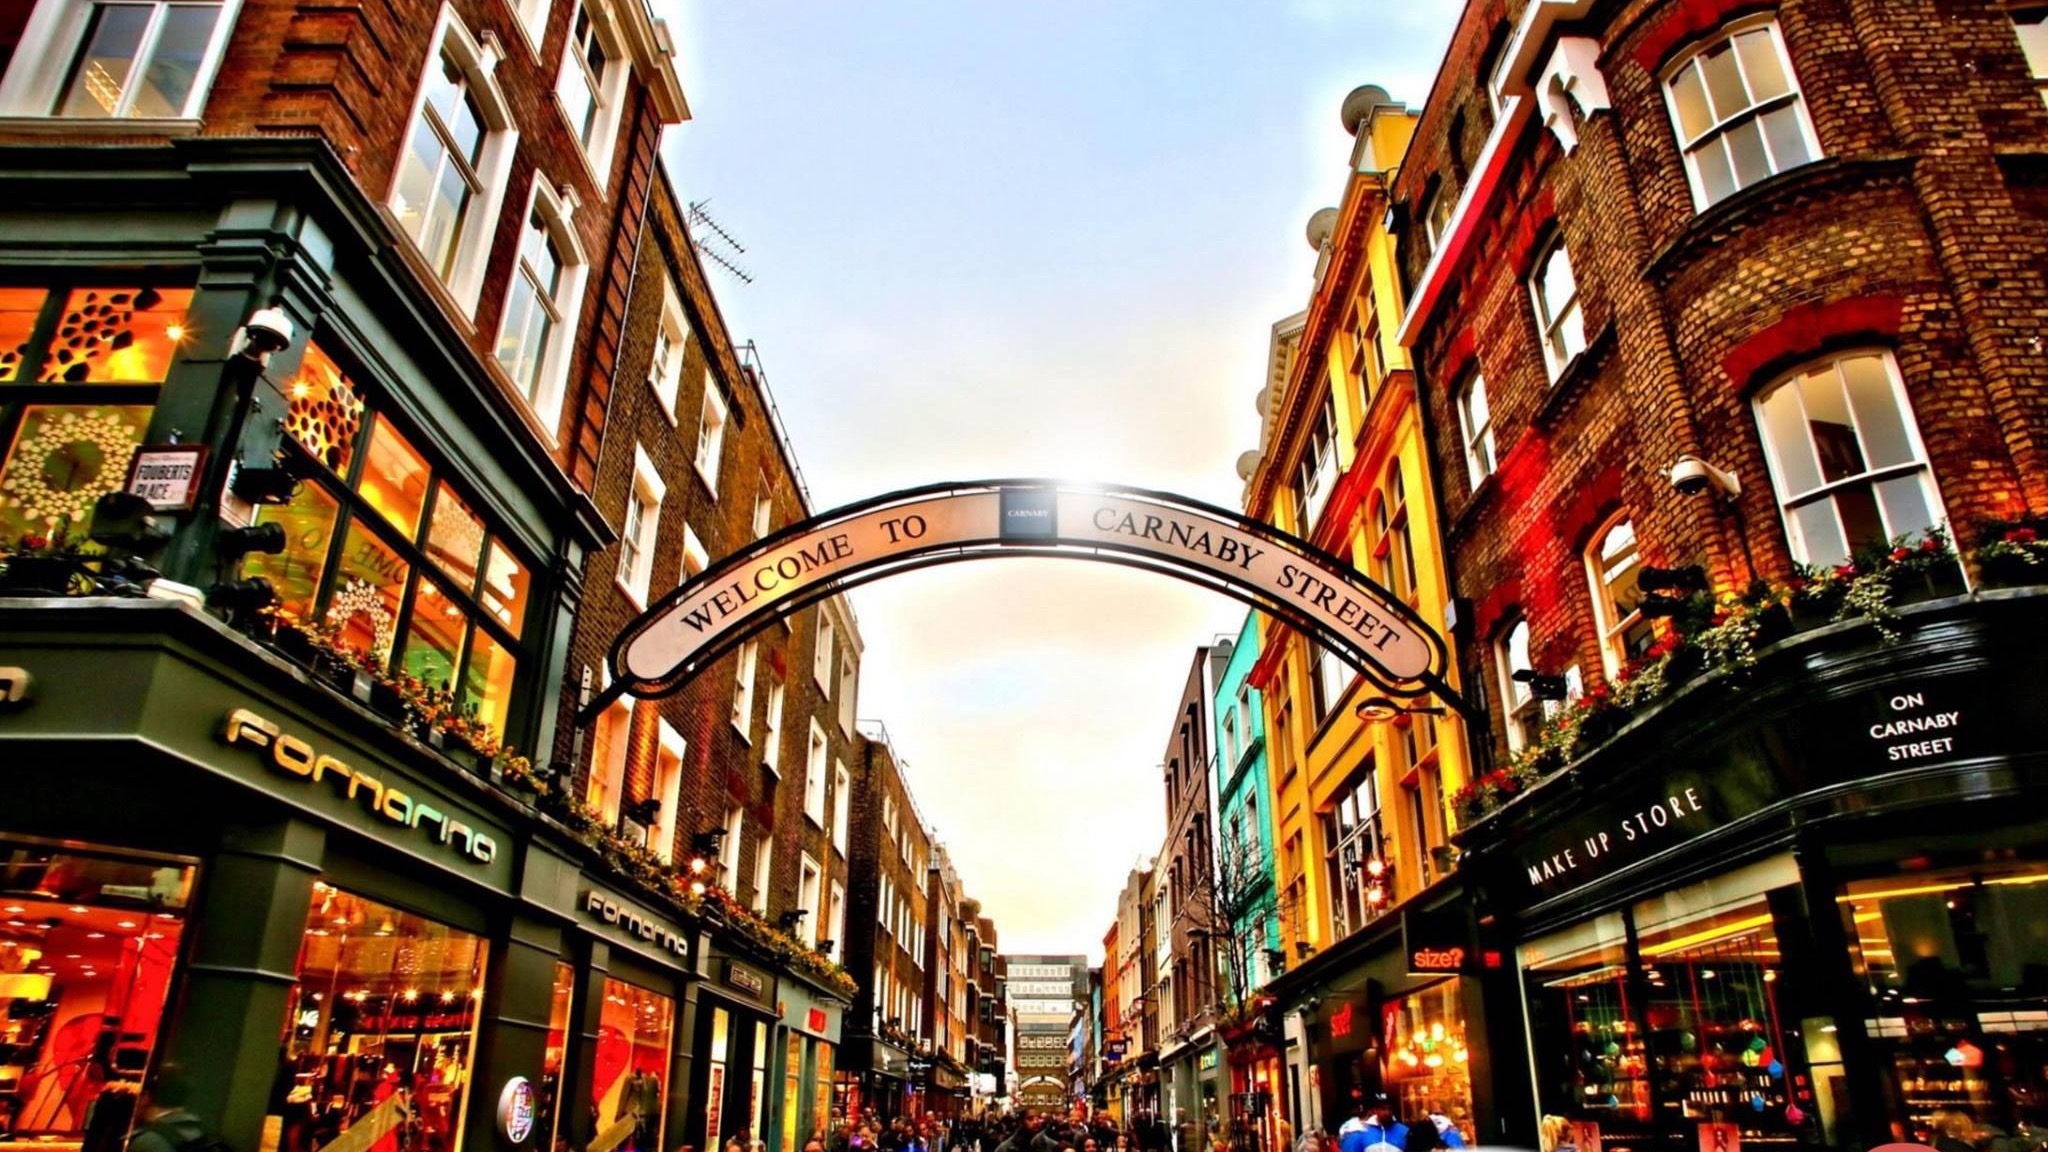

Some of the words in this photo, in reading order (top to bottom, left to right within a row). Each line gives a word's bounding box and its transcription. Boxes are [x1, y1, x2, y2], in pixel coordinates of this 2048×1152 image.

[136, 464, 193, 480] FOUBERTS
[135, 483, 171, 499] PLACE
[1008, 509, 1049, 518] CARNABY
[680, 534, 854, 633] WELCOME
[880, 515, 927, 544] TO
[1093, 507, 1264, 571] CARNABY
[1276, 564, 1400, 651] STREET
[1890, 692, 1924, 711] ON
[1870, 711, 1959, 739] CARNABY
[1888, 737, 1953, 760] STREET
[1527, 849, 1577, 886] MAKE
[1584, 831, 1609, 858] UP
[1621, 787, 1702, 841] STORE
[1413, 947, 1464, 968] size?
